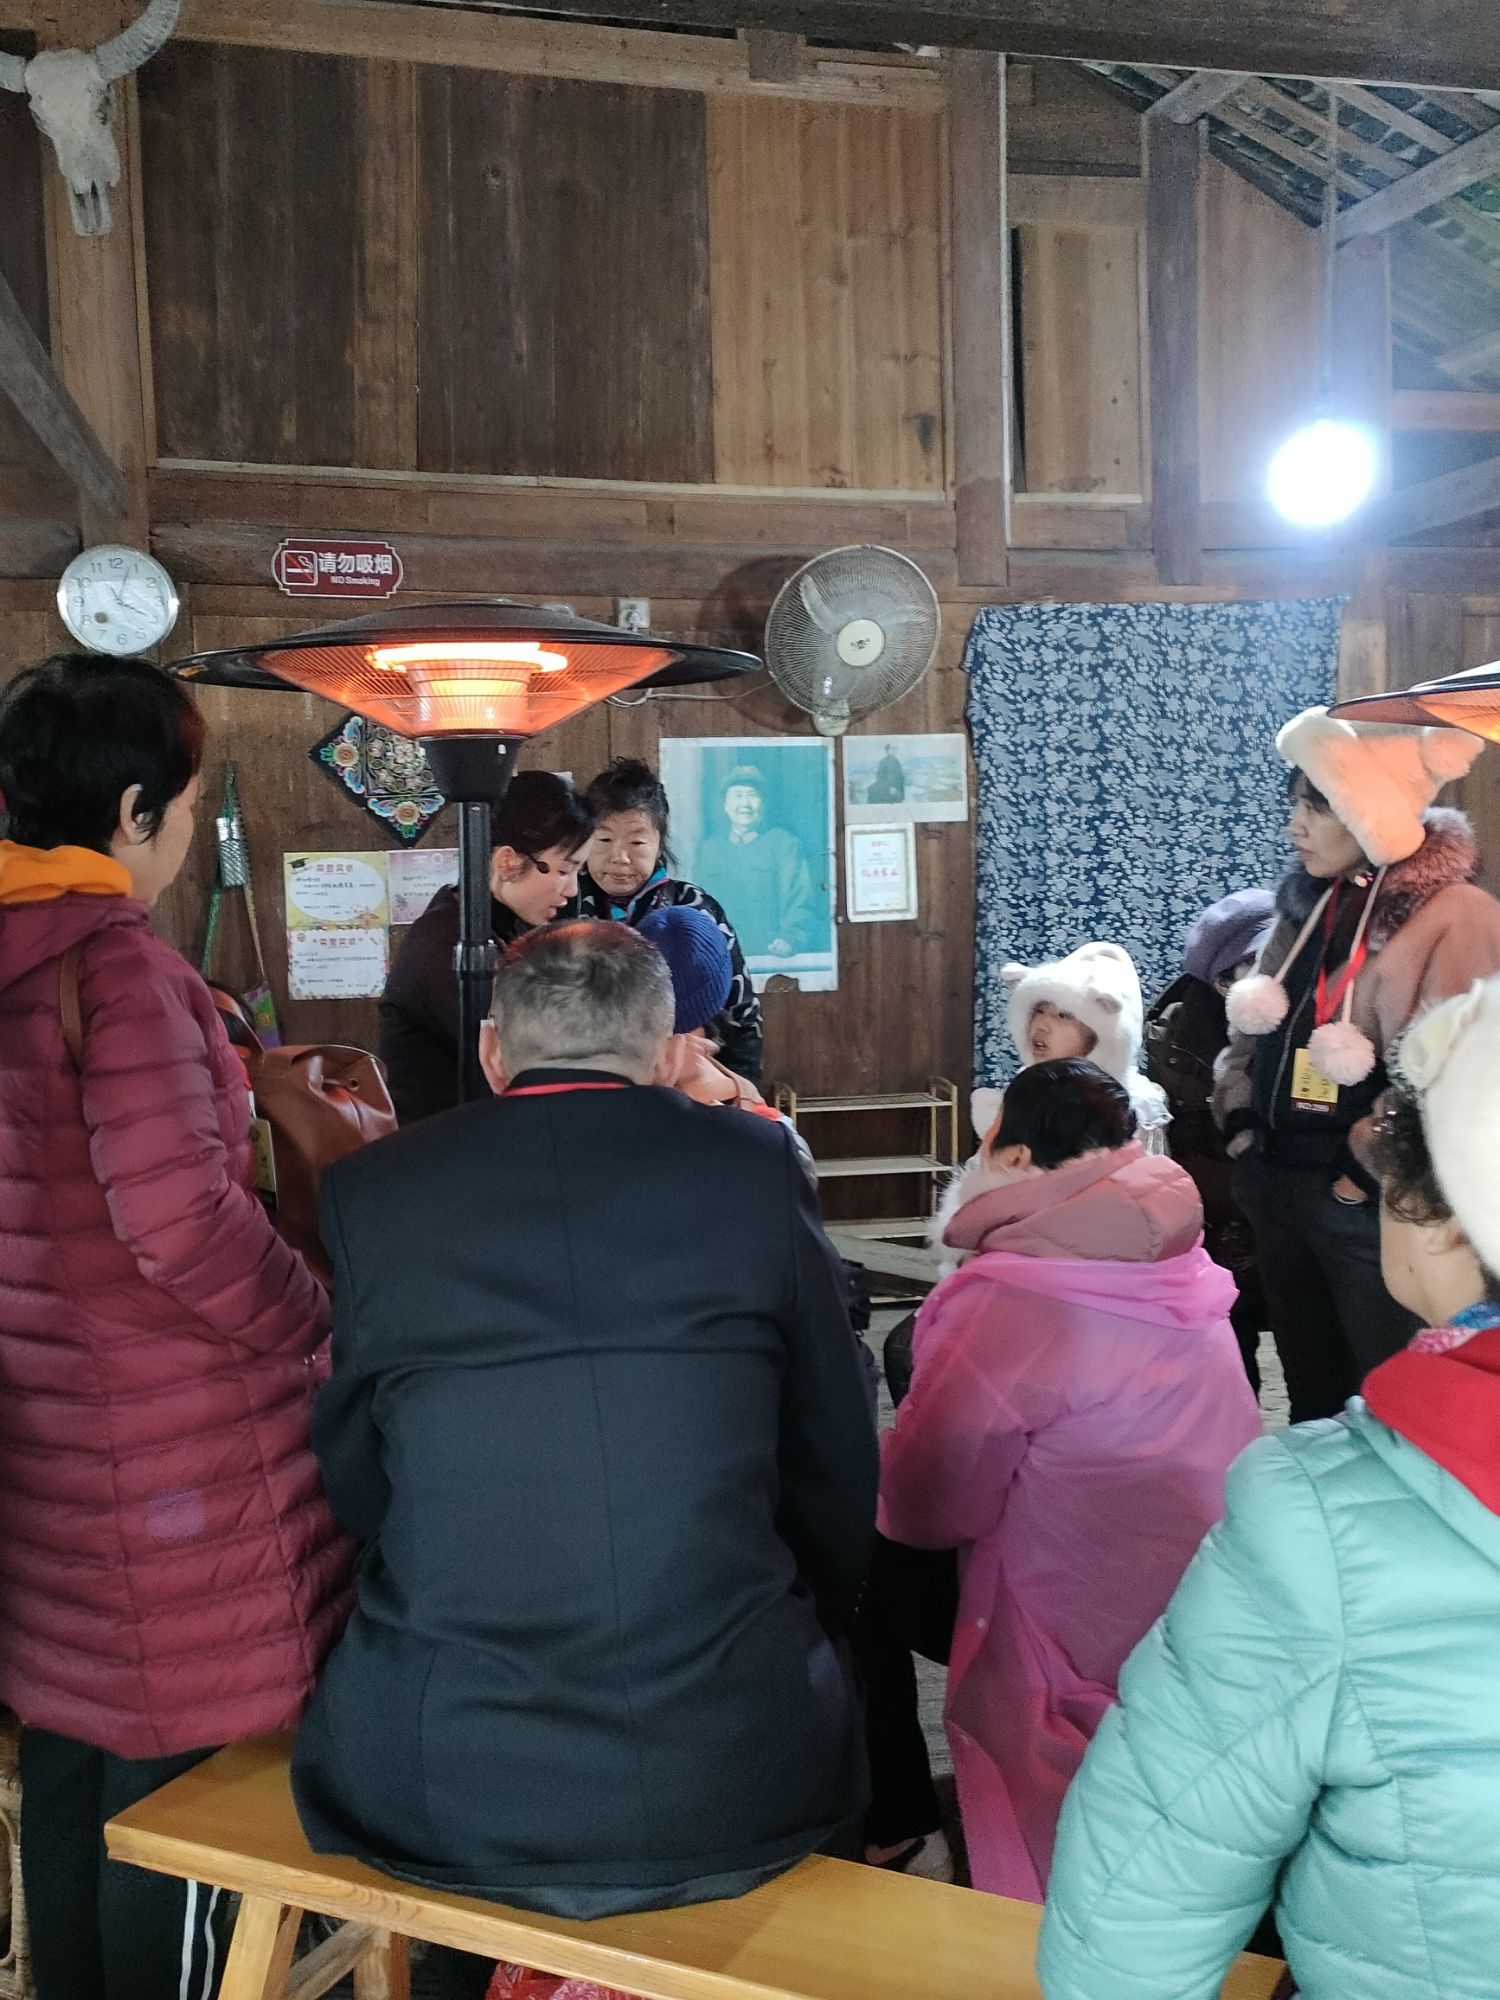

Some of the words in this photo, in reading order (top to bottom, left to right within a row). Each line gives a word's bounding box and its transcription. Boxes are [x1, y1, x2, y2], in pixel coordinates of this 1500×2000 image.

[90, 562, 103, 573] 11
[108, 557, 124, 569] 12
[134, 563, 139, 574] 1
[318, 552, 393, 575] 请勿吸烟
[72, 577, 92, 588] 10
[145, 576, 158, 588] 2
[72, 596, 85, 607] 9
[96, 629, 108, 640] 7
[117, 633, 128, 645] 6
